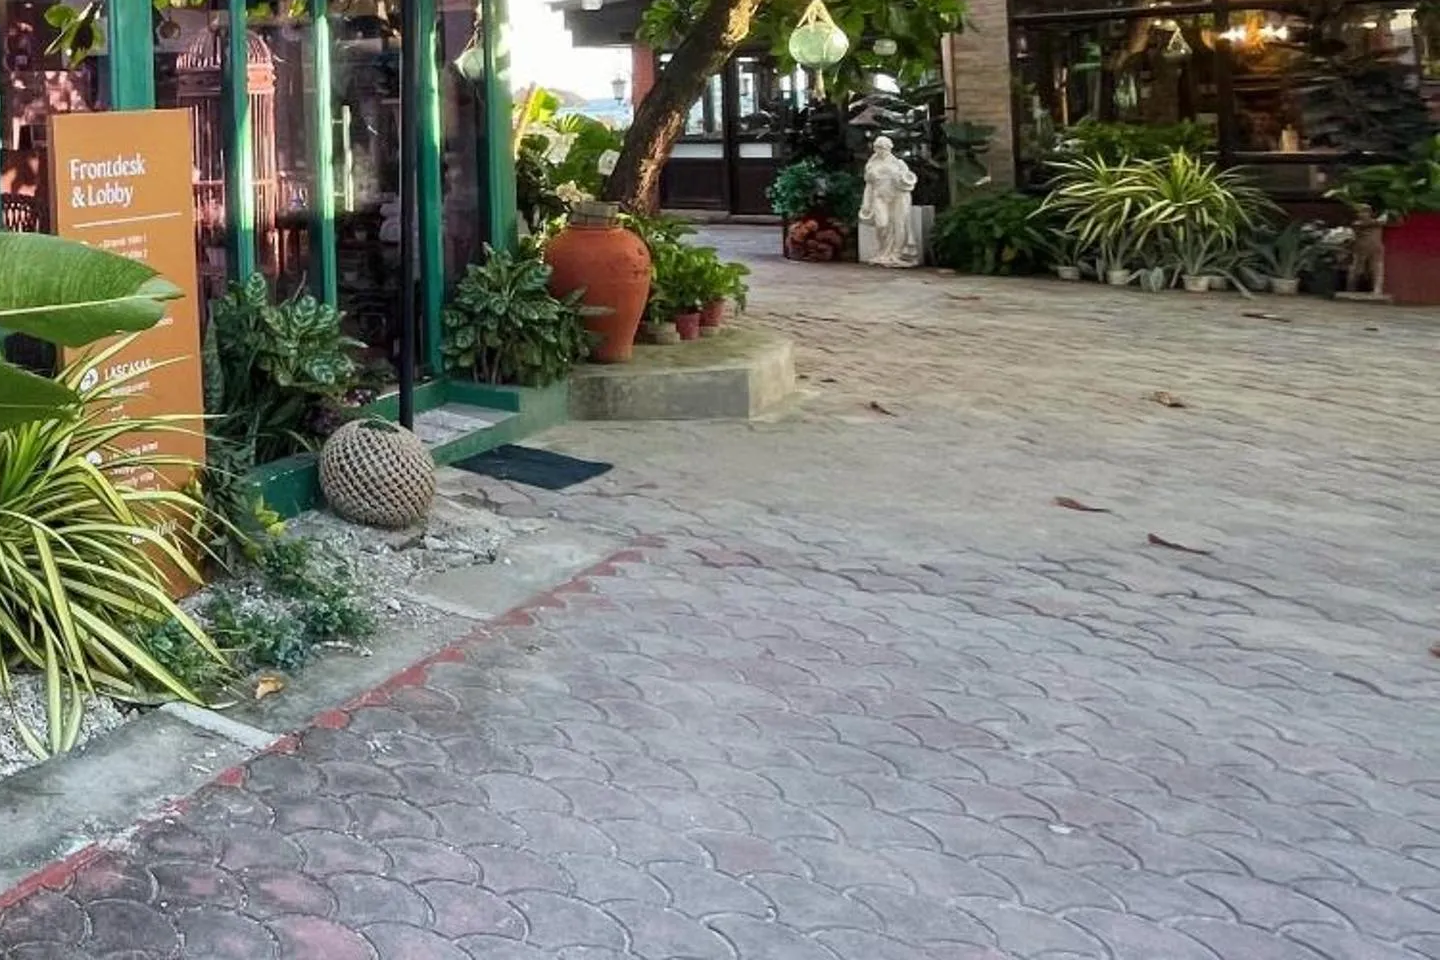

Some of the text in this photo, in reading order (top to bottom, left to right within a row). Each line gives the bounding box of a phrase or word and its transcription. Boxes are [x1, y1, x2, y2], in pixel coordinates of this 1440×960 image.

[70, 152, 146, 180] Frontdesk
[72, 182, 133, 208] & Lobby
